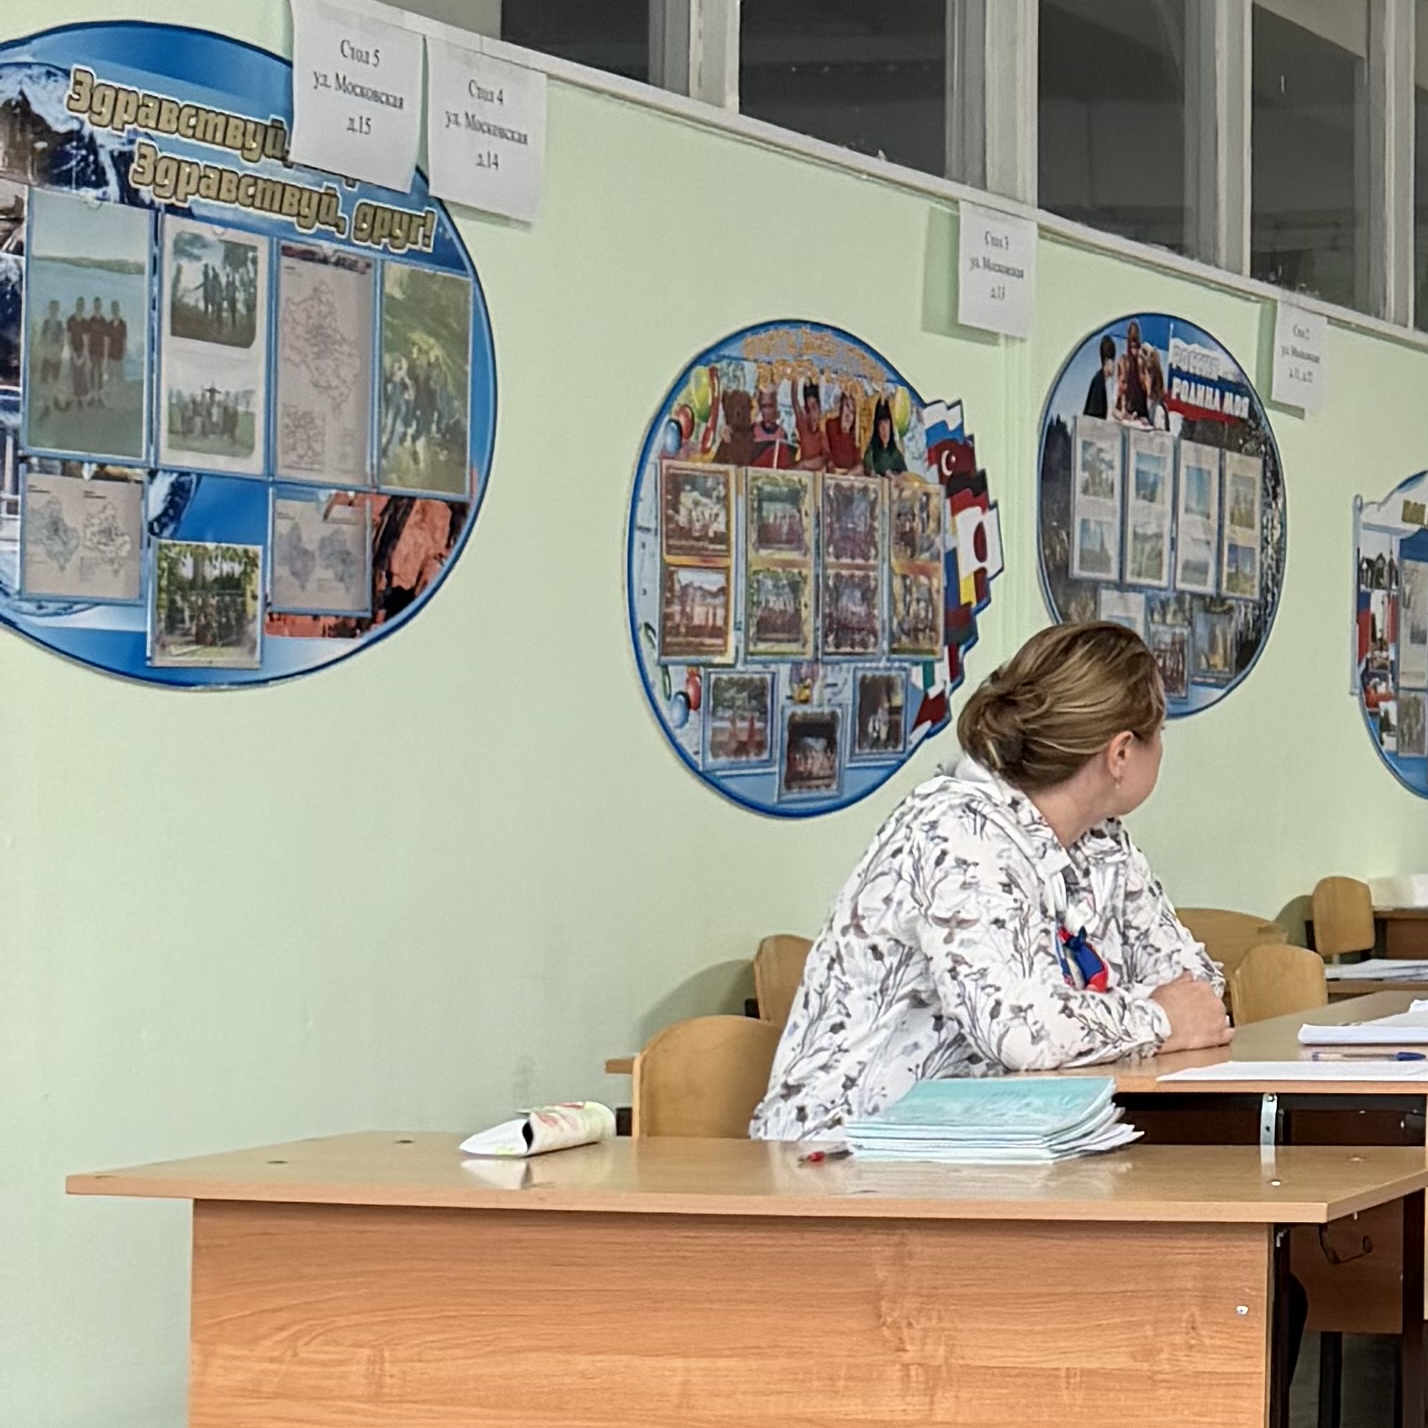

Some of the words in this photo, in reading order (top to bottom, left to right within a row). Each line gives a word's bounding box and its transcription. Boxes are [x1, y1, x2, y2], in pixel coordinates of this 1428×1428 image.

[340, 39, 370, 64] Стол
[373, 49, 380, 67] 5
[313, 71, 332, 89] ул.
[334, 72, 404, 109] Московская
[468, 79, 494, 102] Стол
[497, 88, 504, 105] 4
[346, 116, 371, 135] д.15
[445, 110, 461, 128] ул.
[464, 111, 528, 145] Московская
[476, 151, 499, 170] д.14
[131, 142, 345, 236] Здравствуй,
[354, 202, 434, 248] друг!
[1171, 376, 1221, 412] РОДИНА
[1222, 391, 1250, 419] МОЯ
